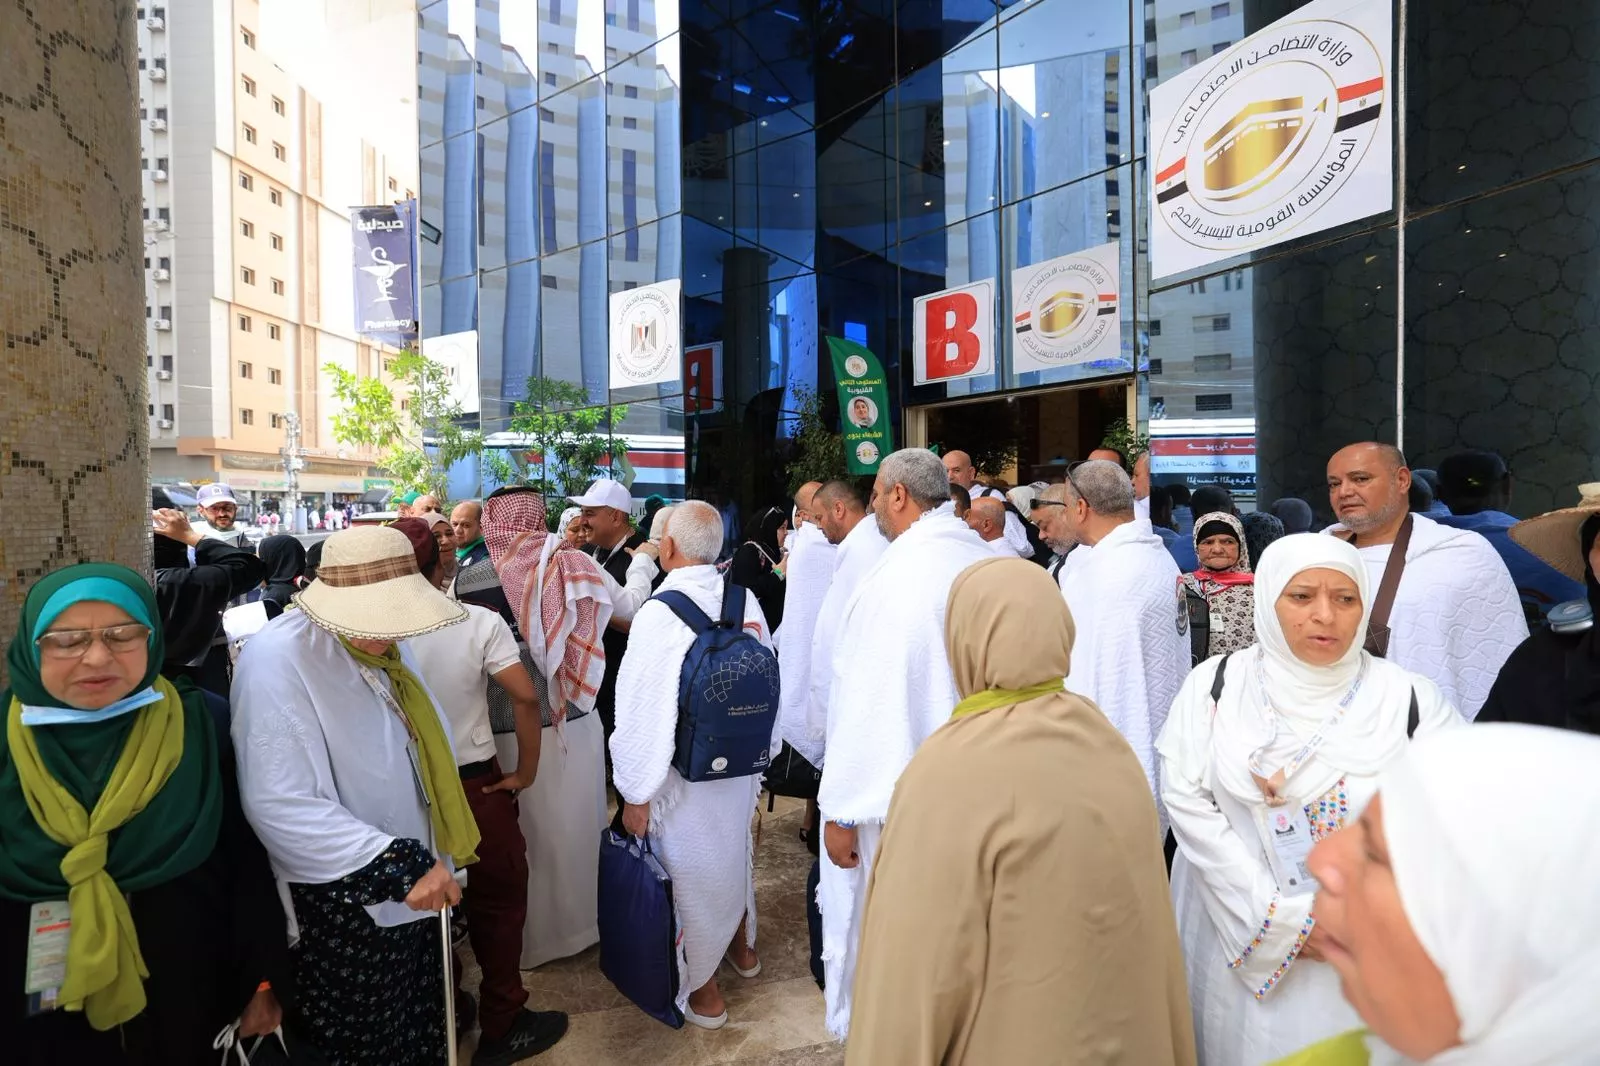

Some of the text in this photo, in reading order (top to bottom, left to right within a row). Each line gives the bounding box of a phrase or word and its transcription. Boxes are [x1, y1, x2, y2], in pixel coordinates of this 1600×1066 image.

[1173, 34, 1353, 145] وزارة التضامن الاجتماعي
[1170, 138, 1357, 241] المؤسسة القومية لتيسير الحج
[356, 218, 405, 234] صيدلية
[1089, 269, 1104, 287] وزارة
[364, 317, 411, 330] Pharmacy
[926, 292, 981, 381] B
[637, 369, 654, 378] Social
